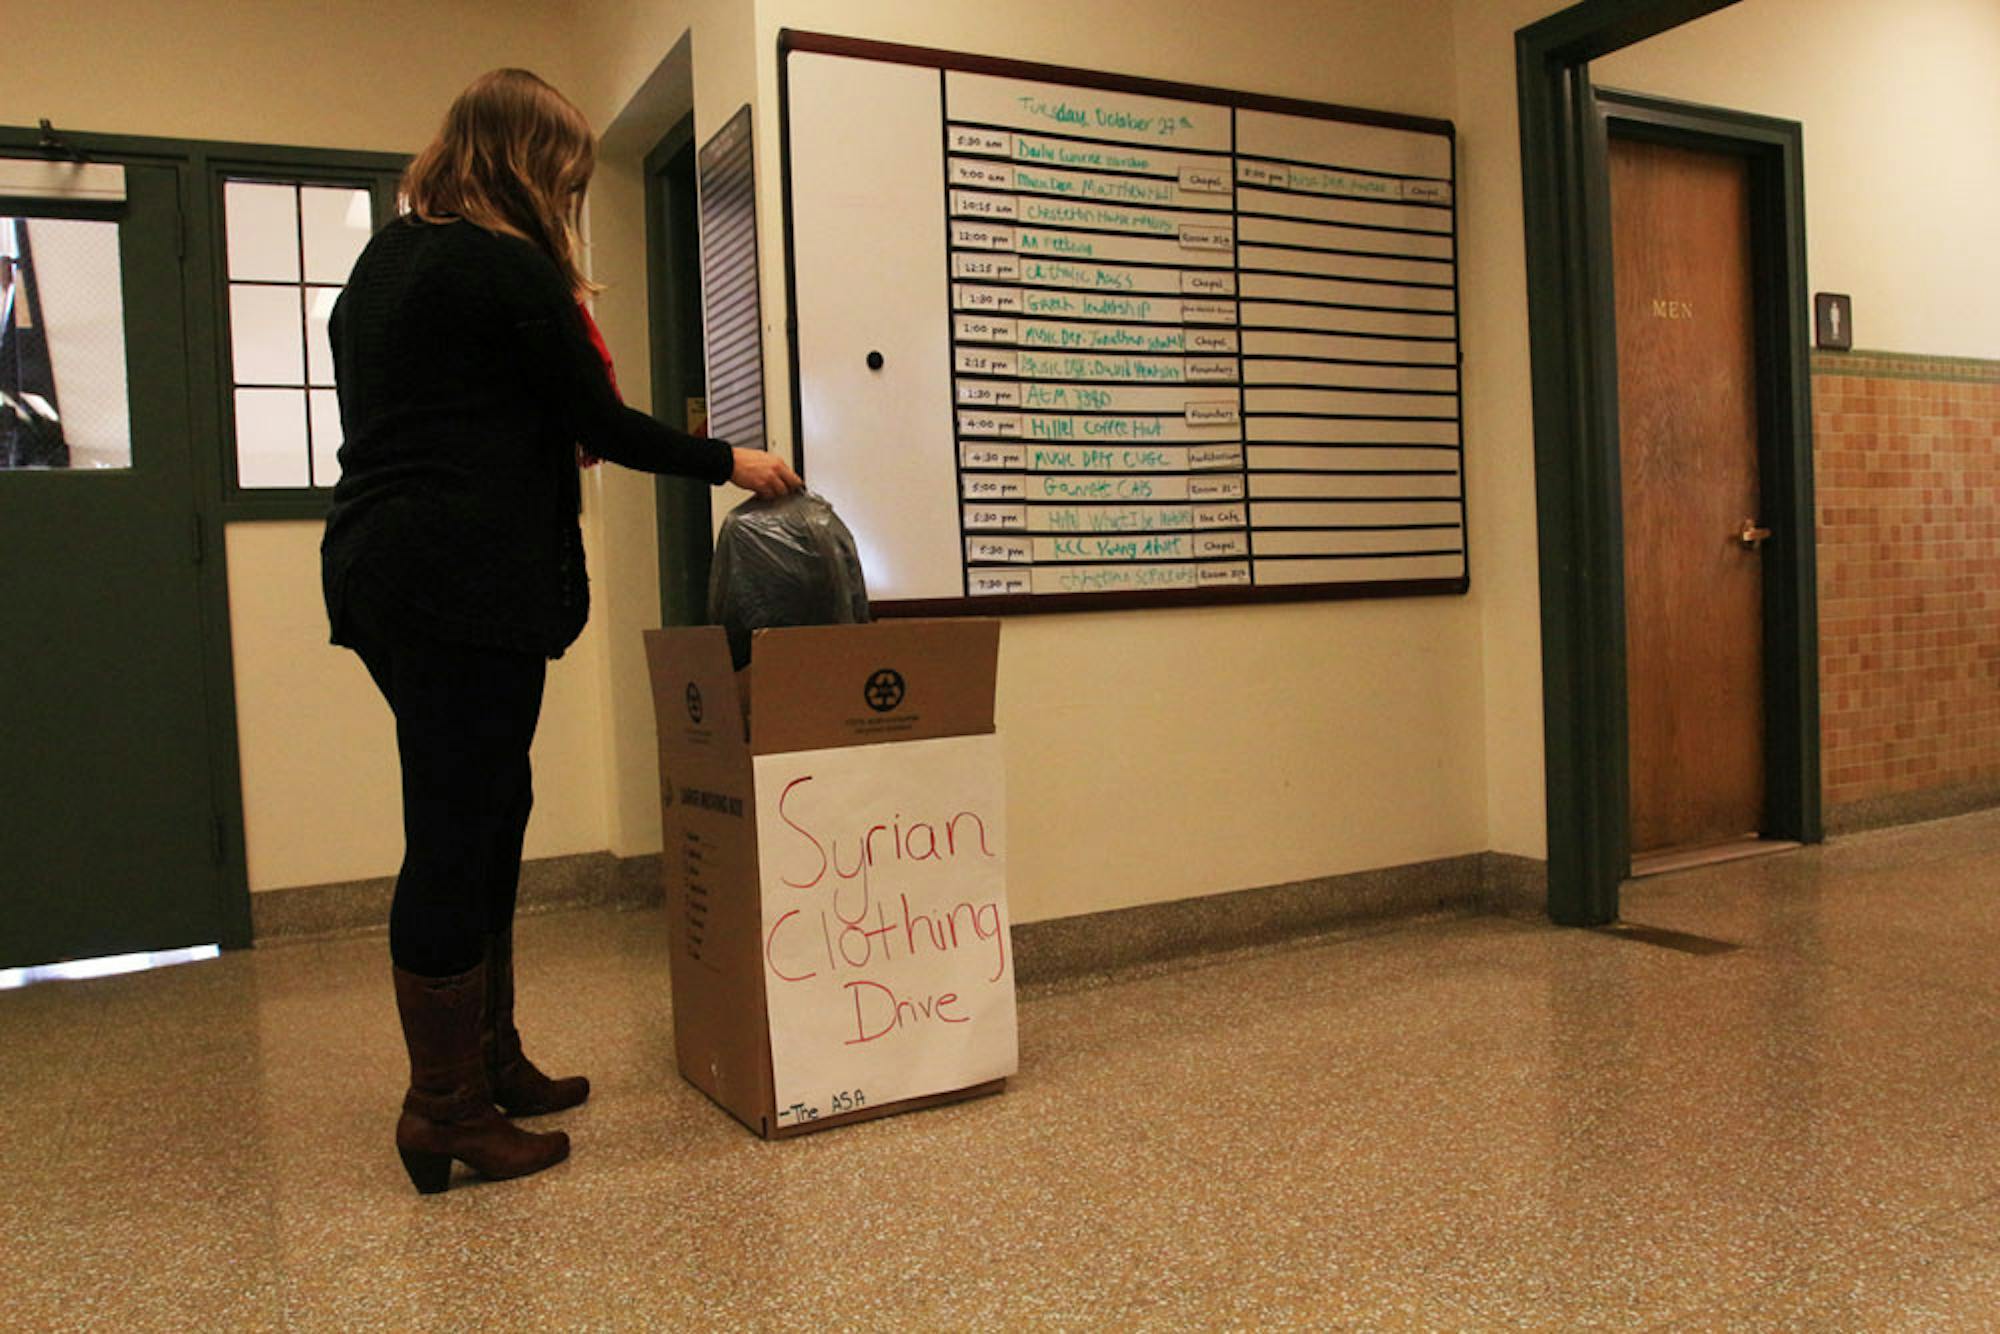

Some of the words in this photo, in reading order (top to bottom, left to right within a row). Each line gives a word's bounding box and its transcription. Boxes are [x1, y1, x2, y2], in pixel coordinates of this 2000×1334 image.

[1018, 96, 1088, 128] Tuesday
[1095, 107, 1152, 132] October
[959, 231, 988, 242] 12:00
[991, 235, 1010, 249] pm
[964, 262, 993, 274] 12:15
[997, 265, 1013, 280] pm
[997, 297, 1014, 313] pm
[1652, 299, 1693, 319] MEN
[963, 323, 989, 335] 1:00
[992, 327, 1009, 342] pm
[991, 361, 1008, 377] pm
[995, 391, 1013, 406] pm
[967, 419, 995, 430] 4:00
[998, 423, 1015, 437] pm
[1002, 455, 1019, 470] pm
[972, 482, 997, 494] 5:00
[1000, 485, 1017, 498] pm
[1001, 515, 1018, 529] pm
[1007, 549, 1024, 561] pm
[1006, 581, 1022, 594] pm
[779, 774, 996, 926] Syrian
[766, 893, 1005, 982] Clothing
[843, 980, 971, 1046] Drive
[832, 1088, 865, 1114] ASA
